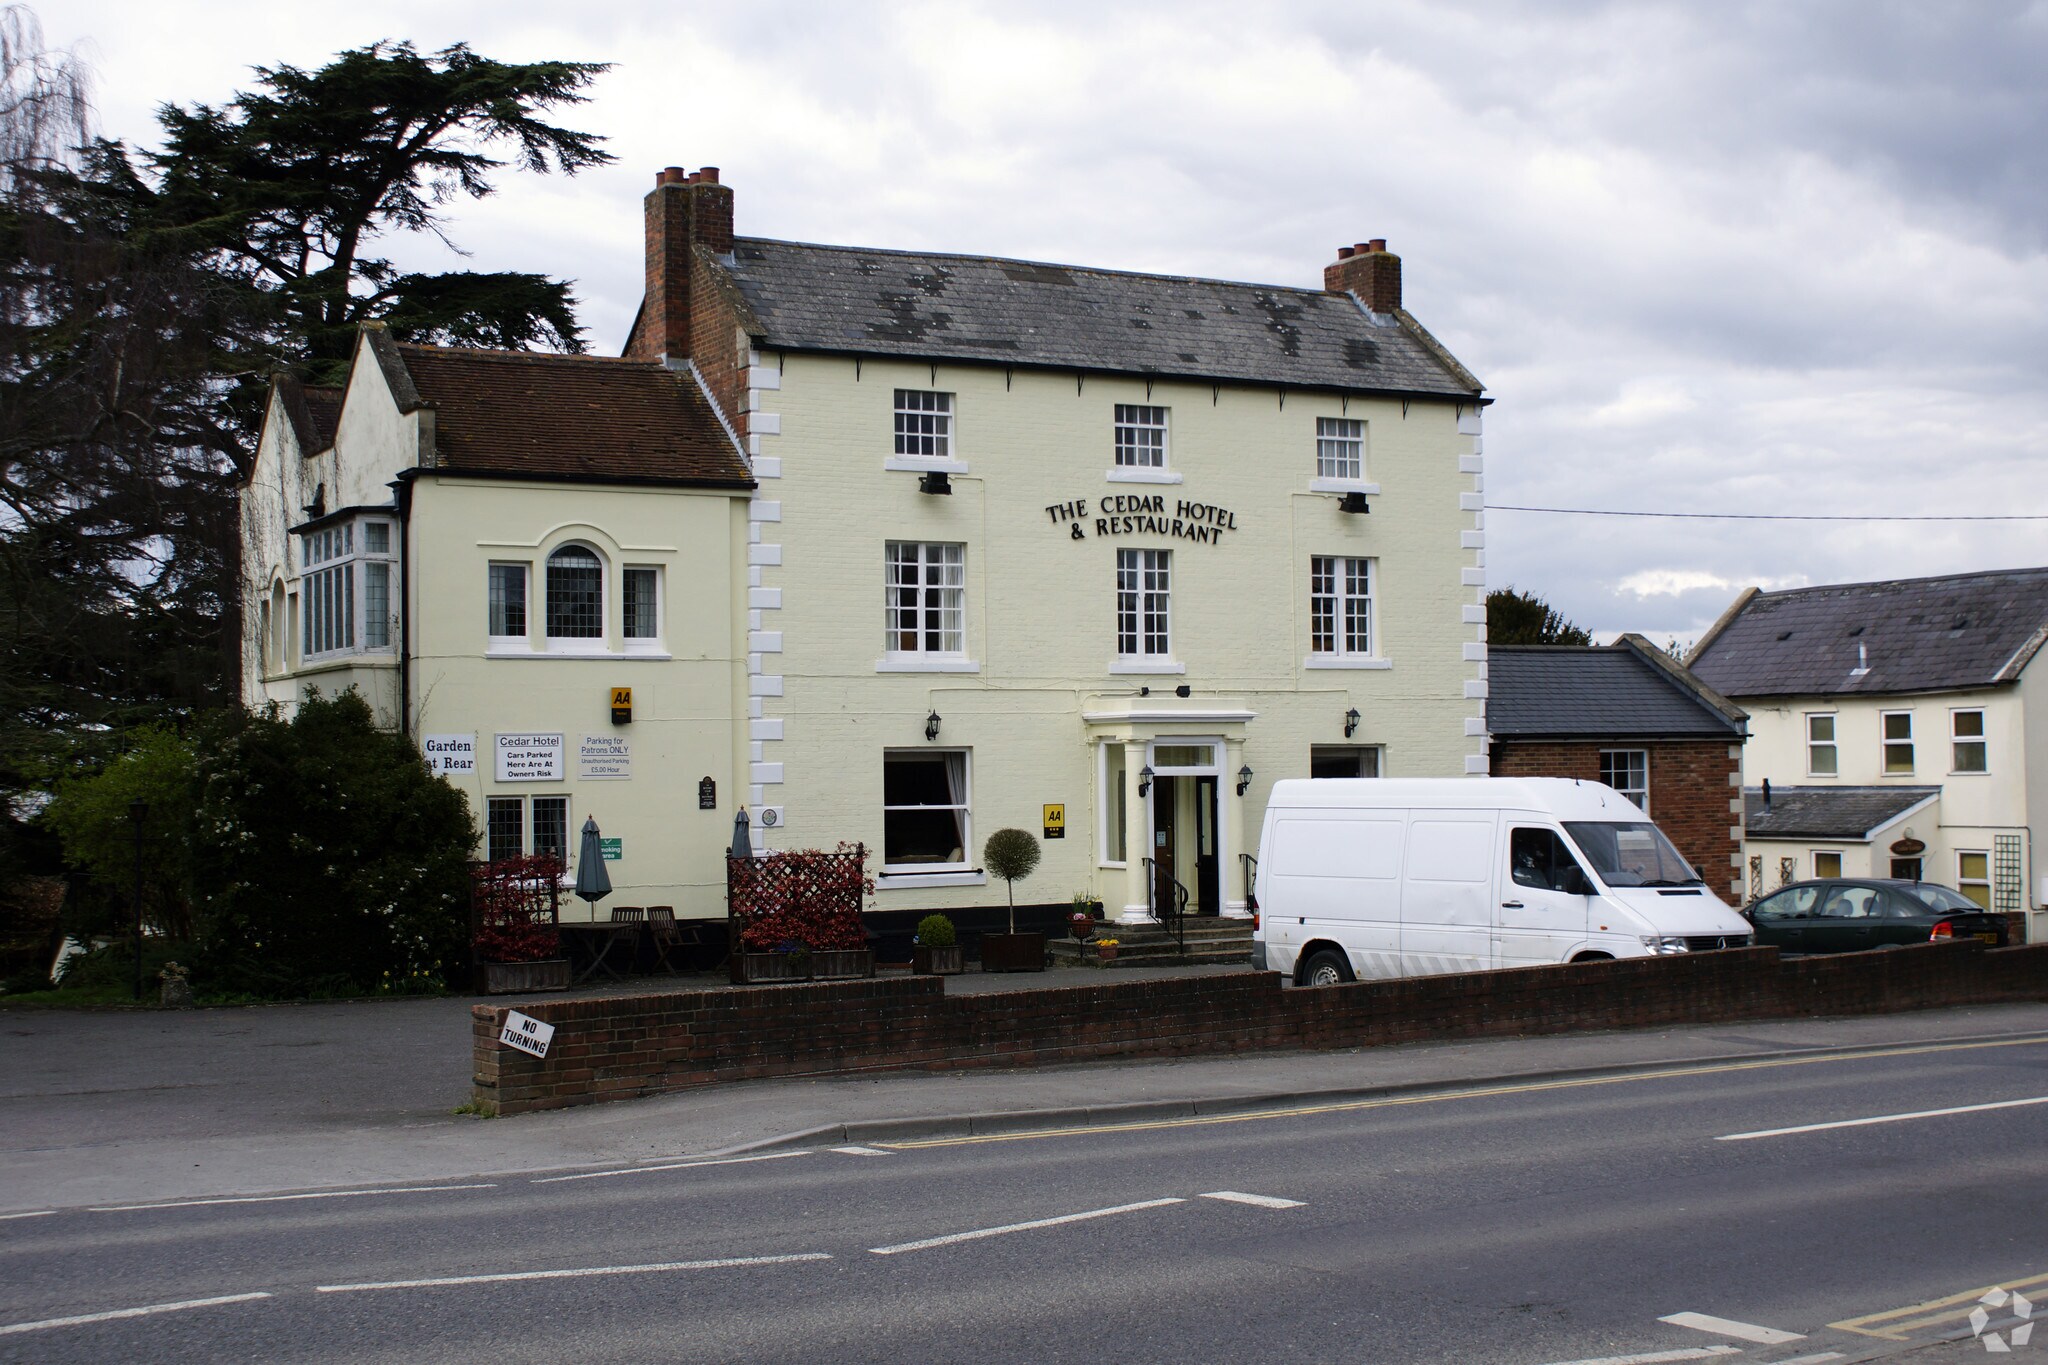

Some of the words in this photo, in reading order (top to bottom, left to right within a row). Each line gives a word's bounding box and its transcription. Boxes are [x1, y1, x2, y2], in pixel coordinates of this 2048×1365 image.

[1045, 499, 1088, 524] THE
[1100, 495, 1165, 514] CEDAR
[1176, 500, 1238, 530] HOTEL
[1071, 522, 1085, 540] &
[1096, 515, 1223, 545] RESTAURANT
[614, 691, 630, 704] AA
[426, 739, 472, 752] Garden
[500, 737, 530, 746] Cedar
[533, 736, 559, 745] Hotel
[586, 737, 613, 746] Parking
[526, 751, 553, 759] Parked
[581, 746, 608, 754] Patrons
[609, 746, 629, 754] ONLY
[443, 757, 474, 769] Rear
[1048, 811, 1061, 822] AA
[522, 1019, 537, 1034] NO
[504, 1028, 546, 1054] TURNING
